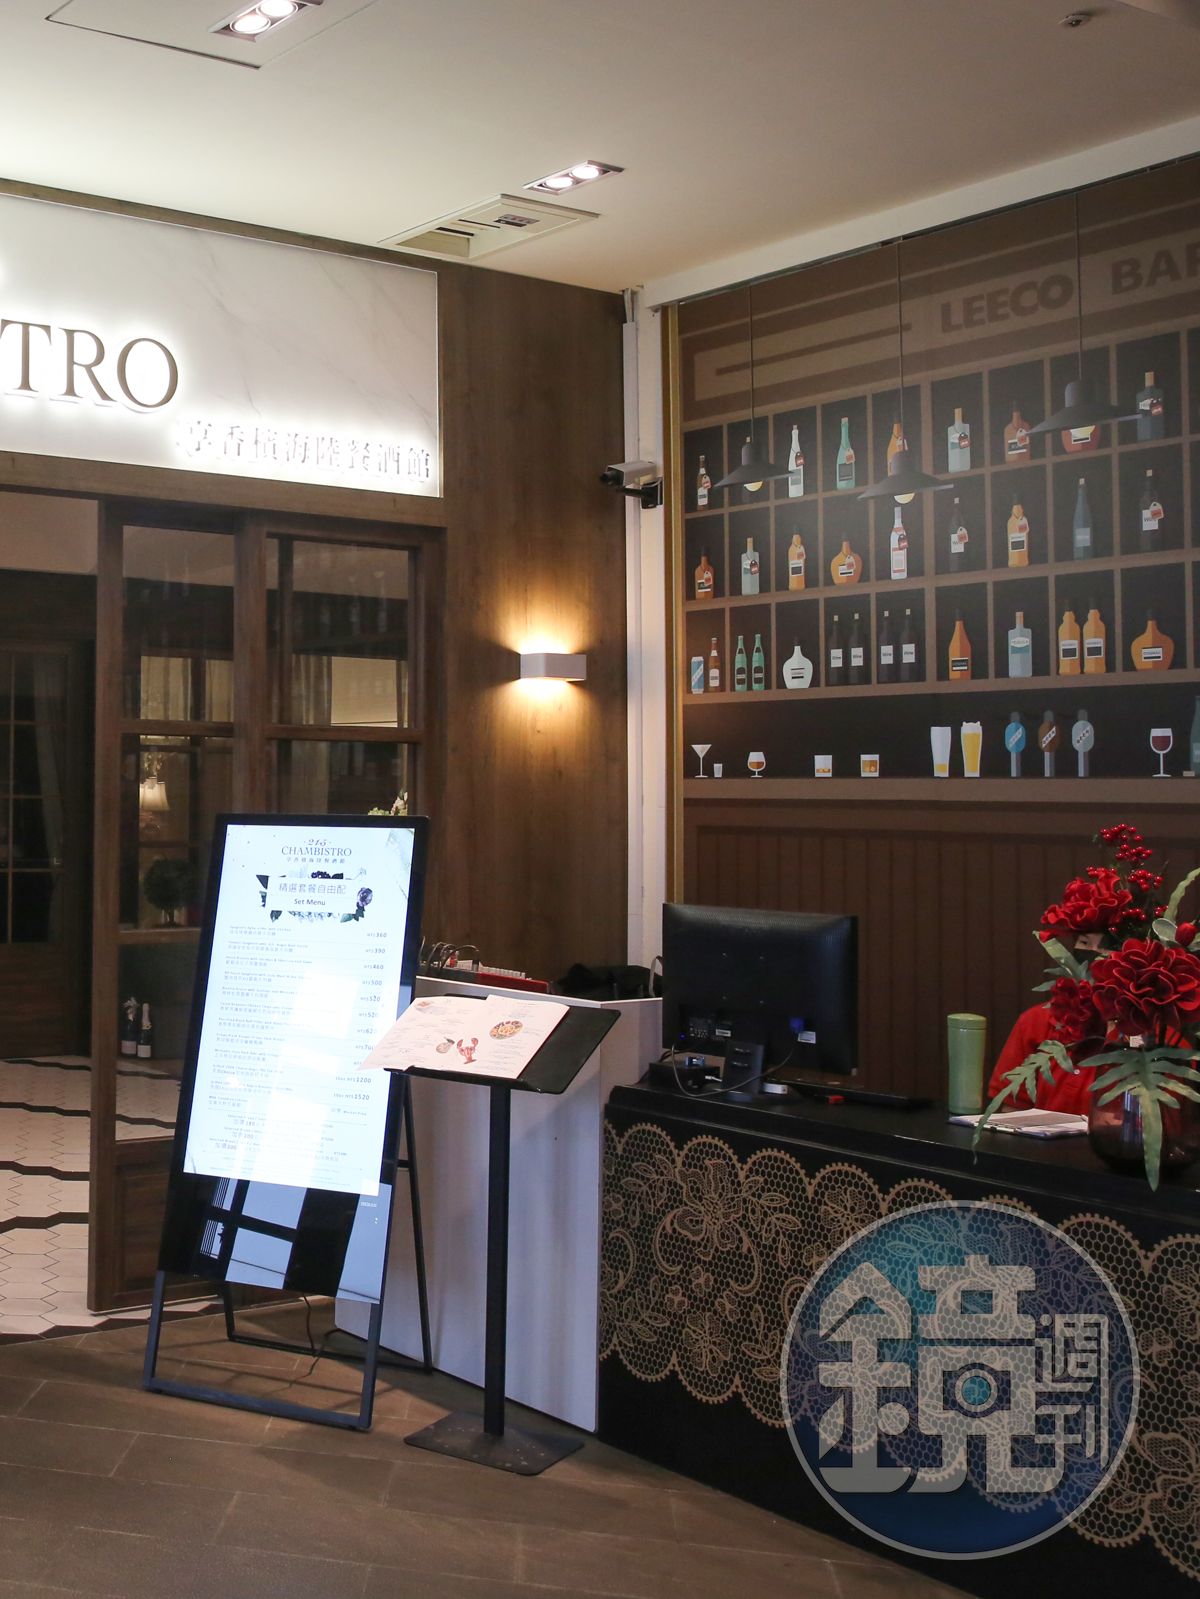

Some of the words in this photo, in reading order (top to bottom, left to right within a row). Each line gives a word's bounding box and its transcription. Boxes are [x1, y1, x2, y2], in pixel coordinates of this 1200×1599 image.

[940, 273, 1075, 334] LEECO
[281, 846, 352, 857] CHAMBISTRO
[279, 883, 347, 895] 精選套餐自由配
[294, 898, 305, 906] Set
